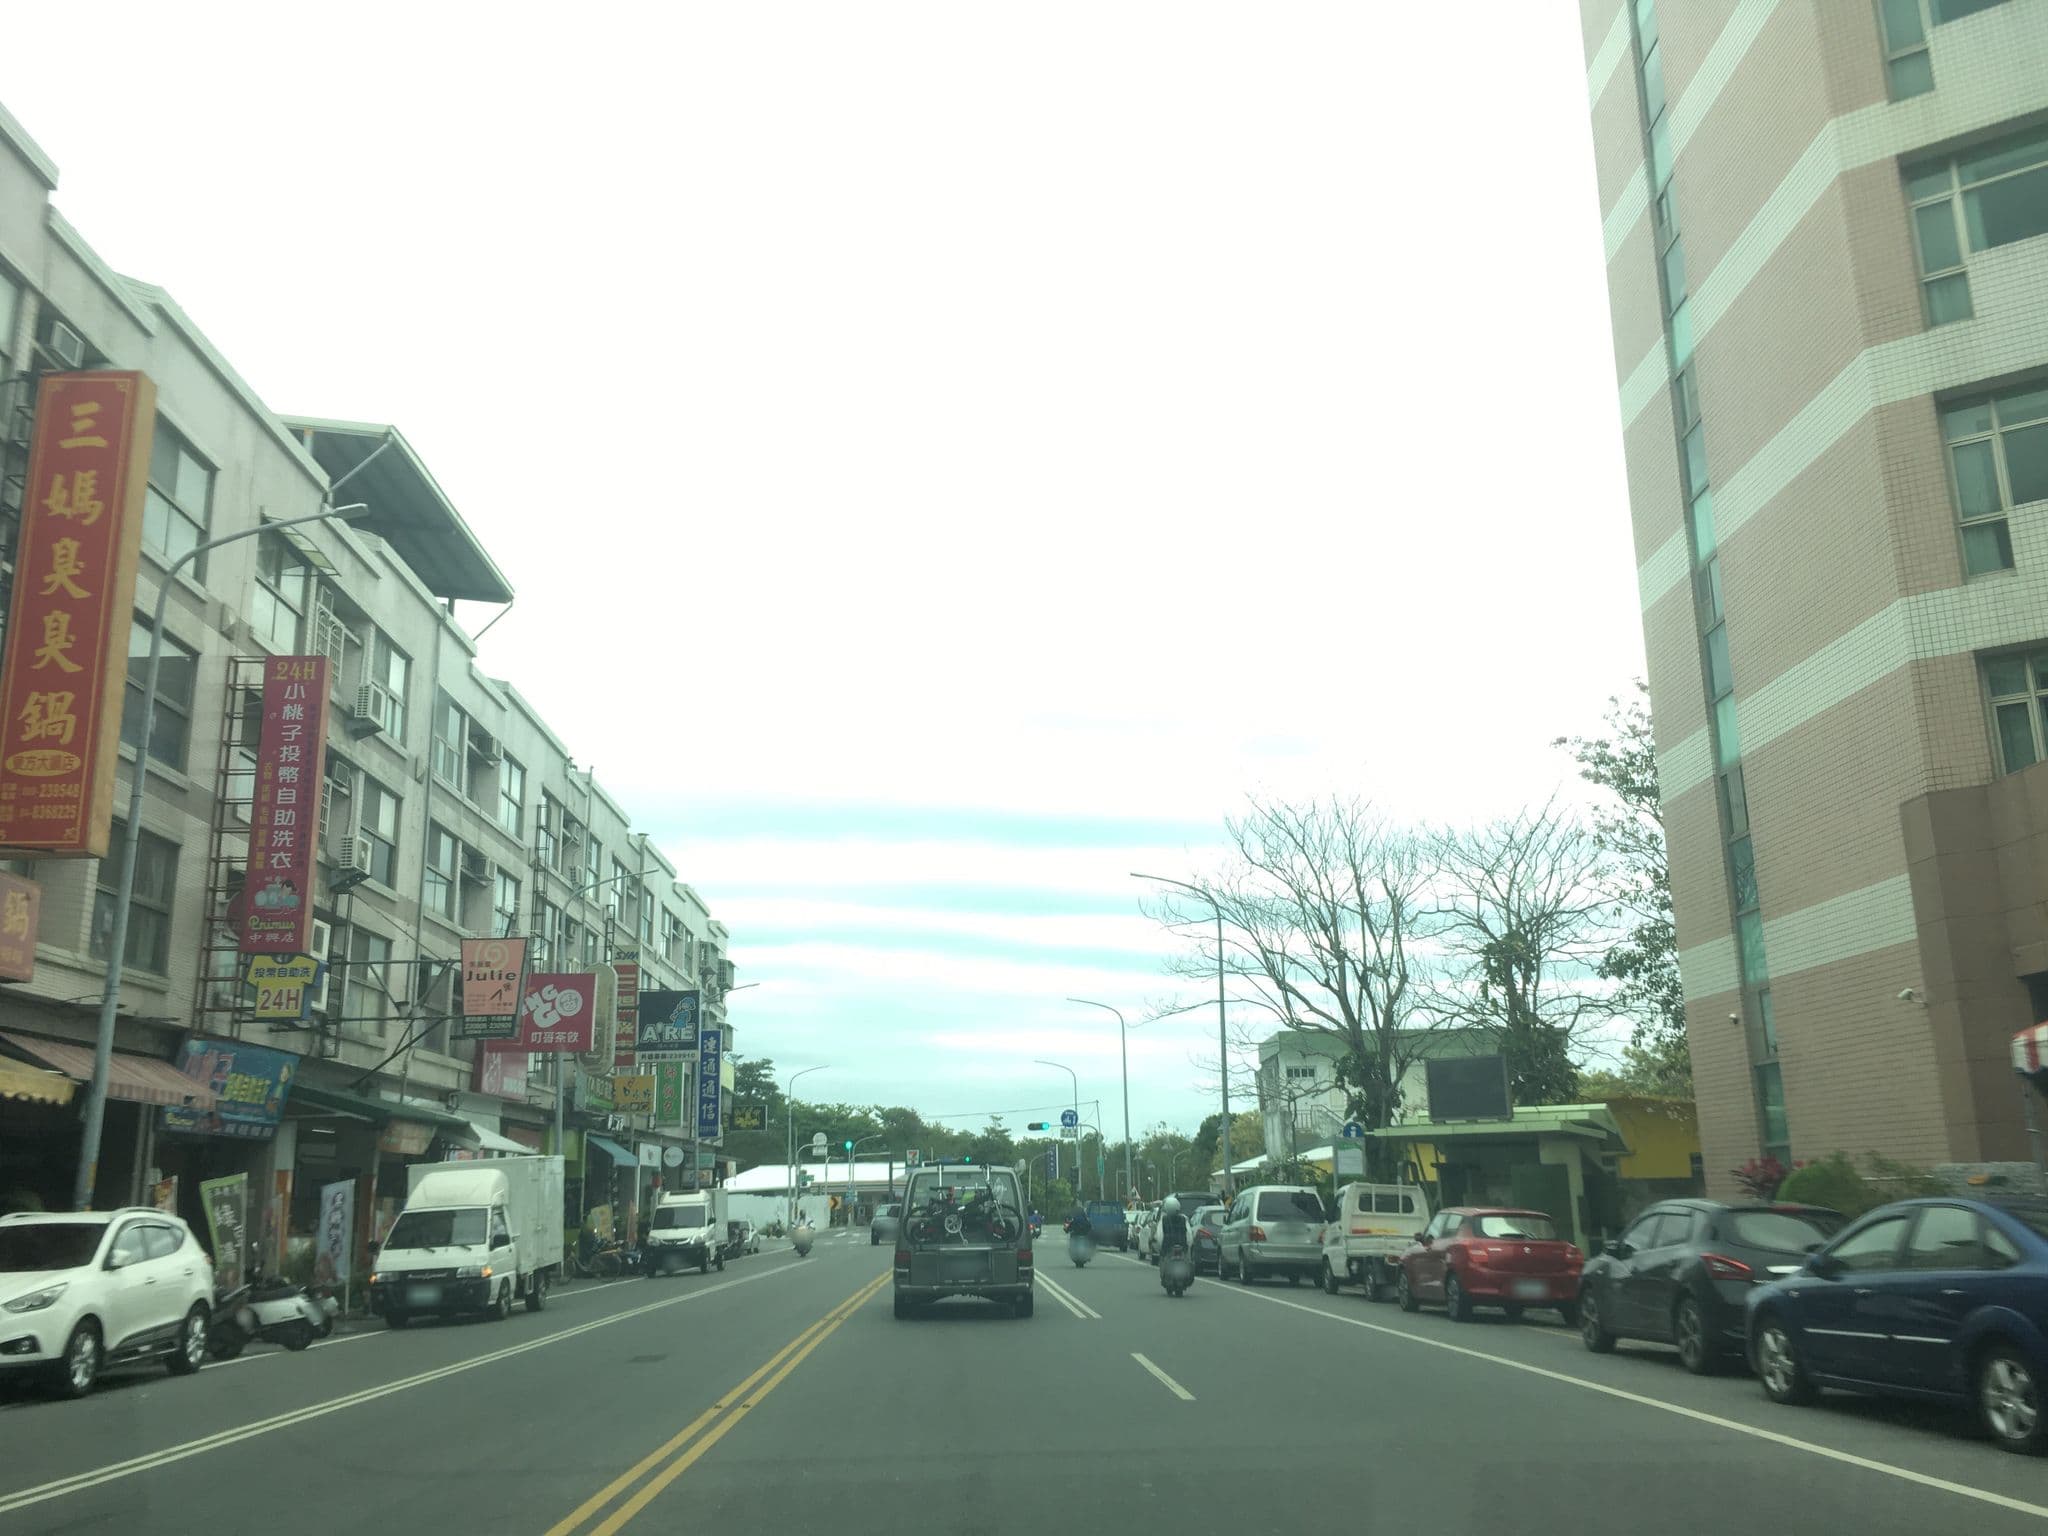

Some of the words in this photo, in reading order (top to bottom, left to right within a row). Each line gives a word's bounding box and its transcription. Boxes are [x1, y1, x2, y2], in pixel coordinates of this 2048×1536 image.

[17, 400, 109, 746] 三媽臭臭鍋
[272, 661, 317, 680] 24H
[270, 682, 306, 870] 小桃子投幣自助洗衣
[615, 951, 639, 960] SYM
[466, 969, 517, 982] Julie
[259, 989, 301, 1011] 24H
